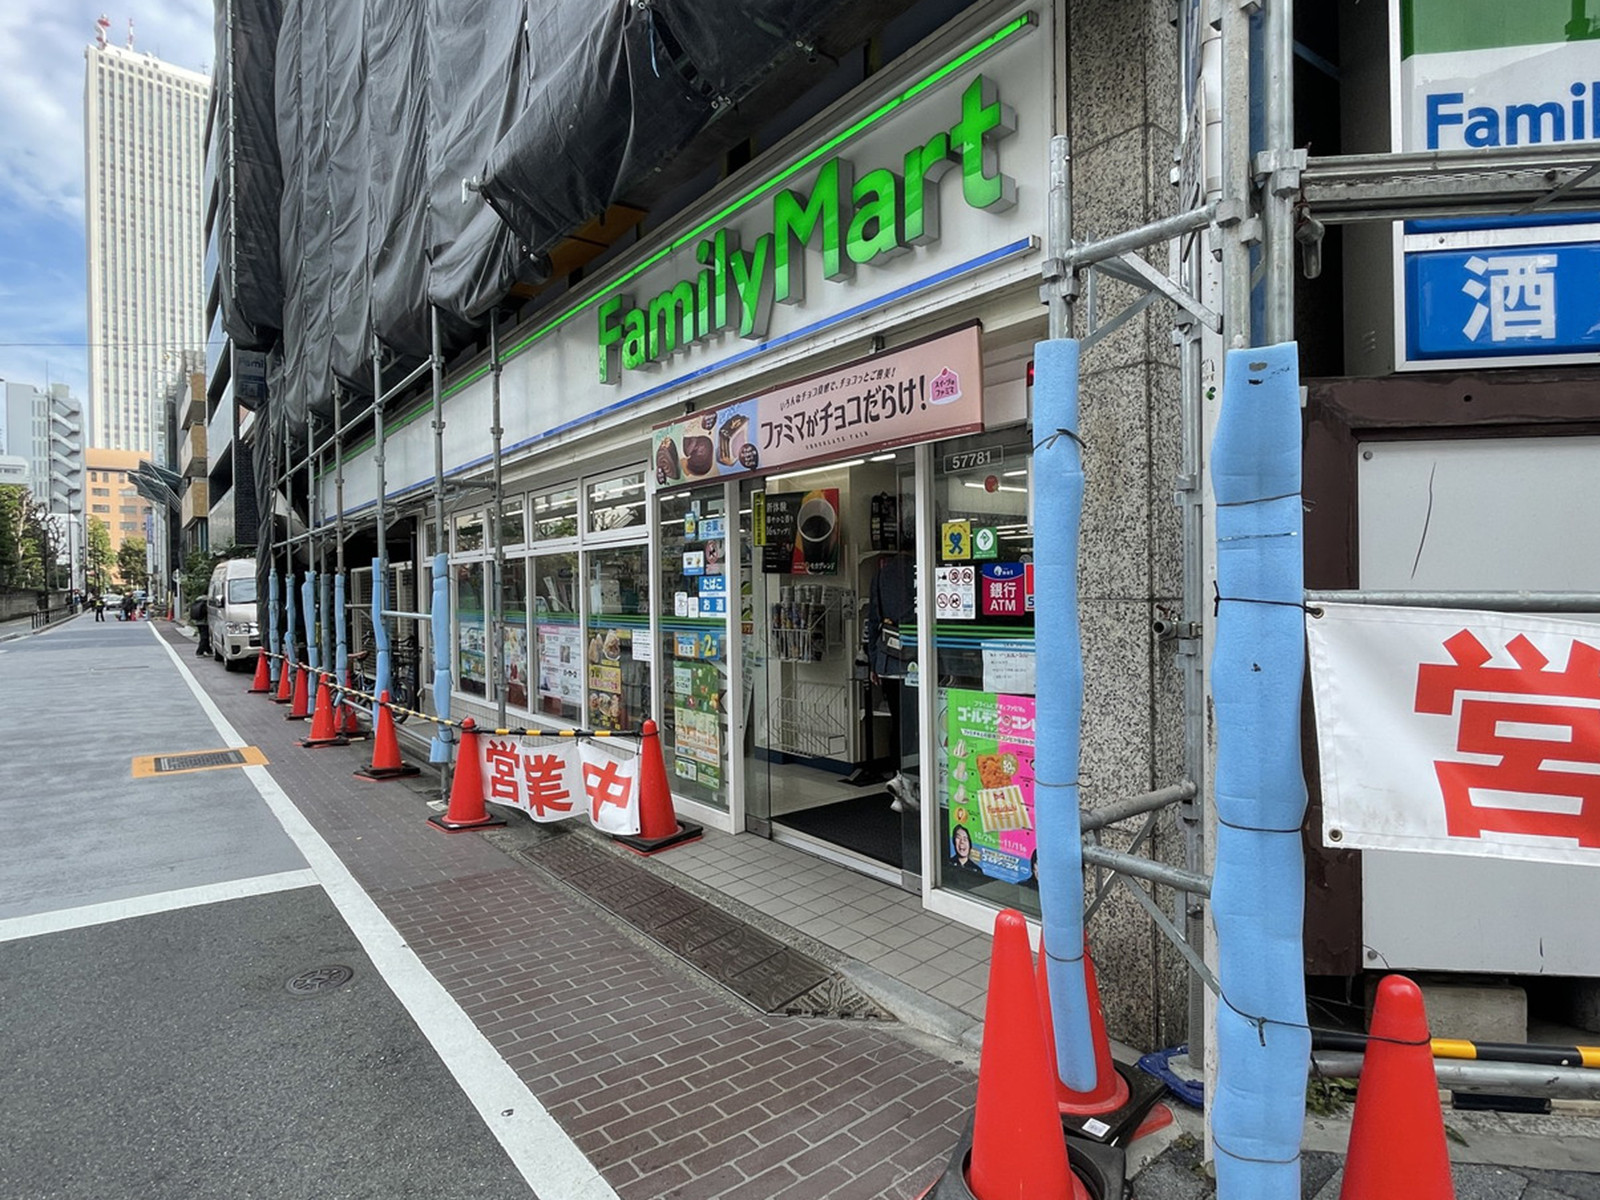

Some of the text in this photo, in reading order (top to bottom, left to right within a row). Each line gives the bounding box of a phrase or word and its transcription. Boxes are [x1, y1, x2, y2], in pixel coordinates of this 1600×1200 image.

[599, 74, 1005, 384] FamilyMart
[1461, 254, 1558, 342] 酒
[760, 375, 927, 450] ファミマがチョコだらけ!
[951, 451, 992, 469] 57781
[703, 578, 723, 590] たばこ
[989, 582, 1017, 599] 銀行
[989, 599, 1016, 612] ATM
[1414, 628, 1600, 849] 営
[486, 739, 633, 823] 営業中
